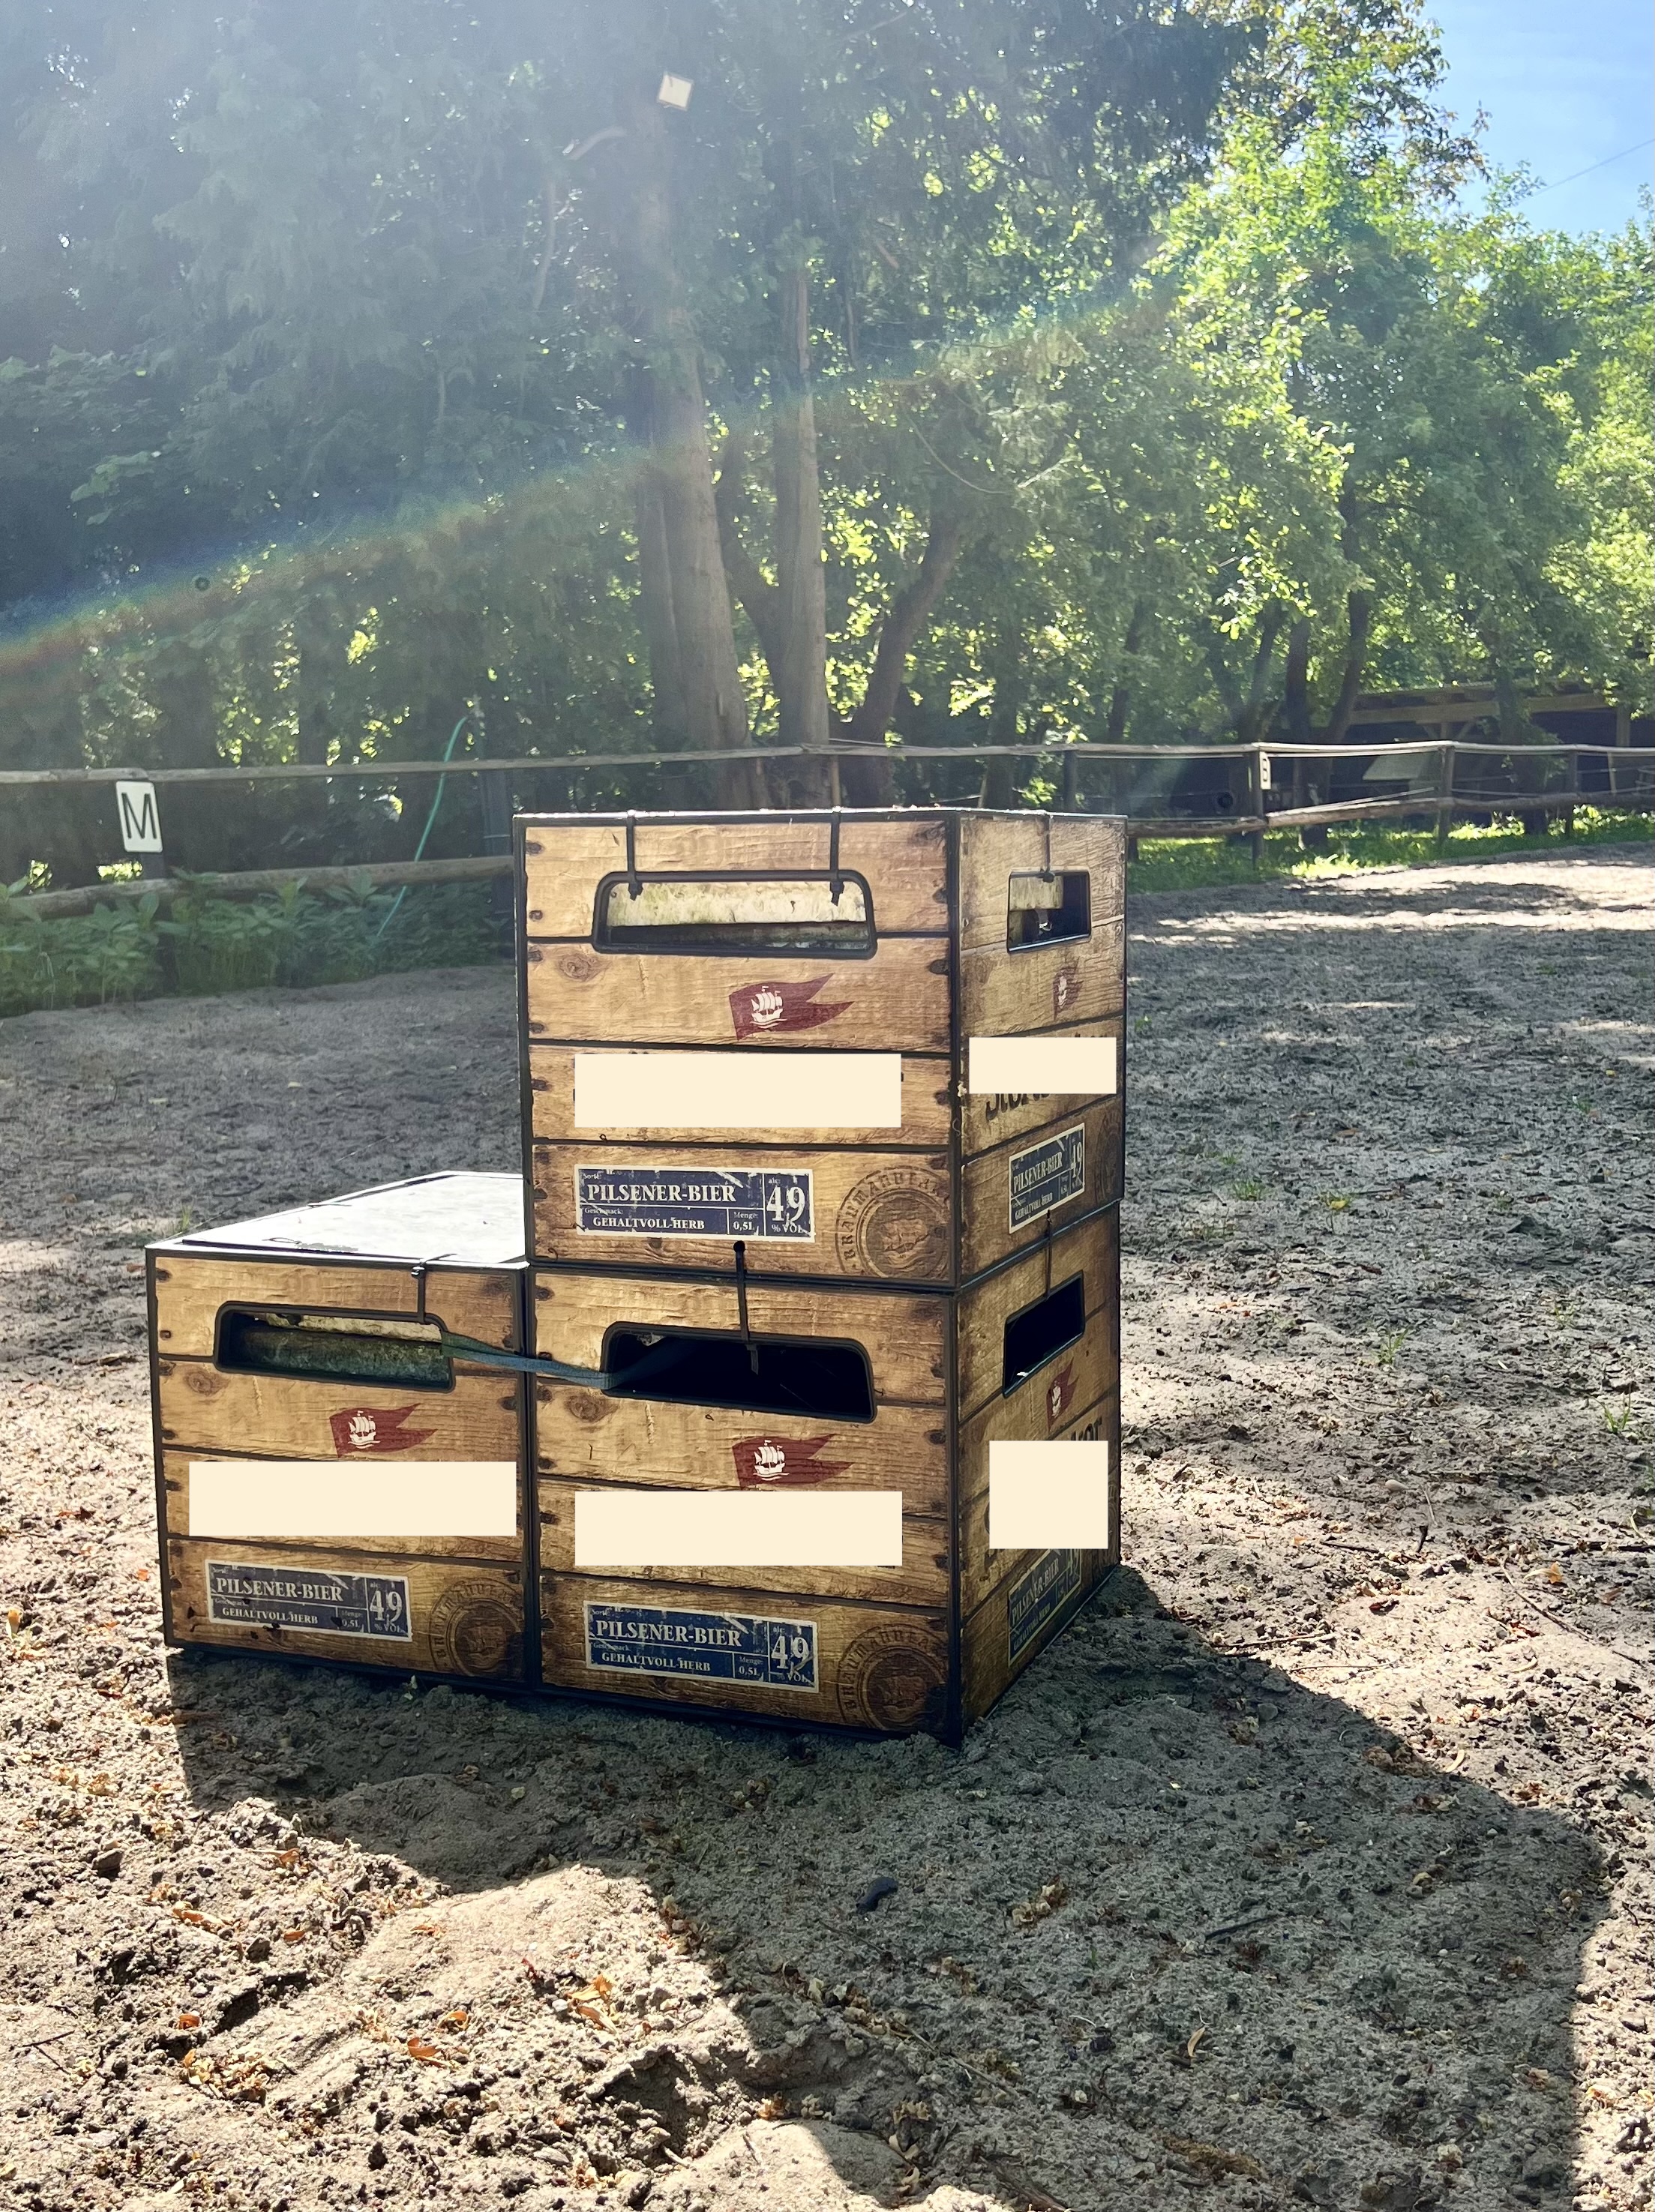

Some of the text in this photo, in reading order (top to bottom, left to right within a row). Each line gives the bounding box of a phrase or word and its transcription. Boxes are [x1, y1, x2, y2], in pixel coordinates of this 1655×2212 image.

[121, 793, 157, 839] M
[1013, 1151, 1063, 1194] PILSENER-BIER
[587, 1184, 736, 1203] PILSENER-BIER
[592, 1217, 705, 1230] GEHALTVOLL-HERB
[216, 1577, 343, 1602] PILSENER-BIER
[222, 1607, 319, 1624] GEHALTVOLL-HERB
[595, 1620, 742, 1647] PILSENER-BIER
[601, 1652, 711, 1672] GEHALTVOLL-HERB
